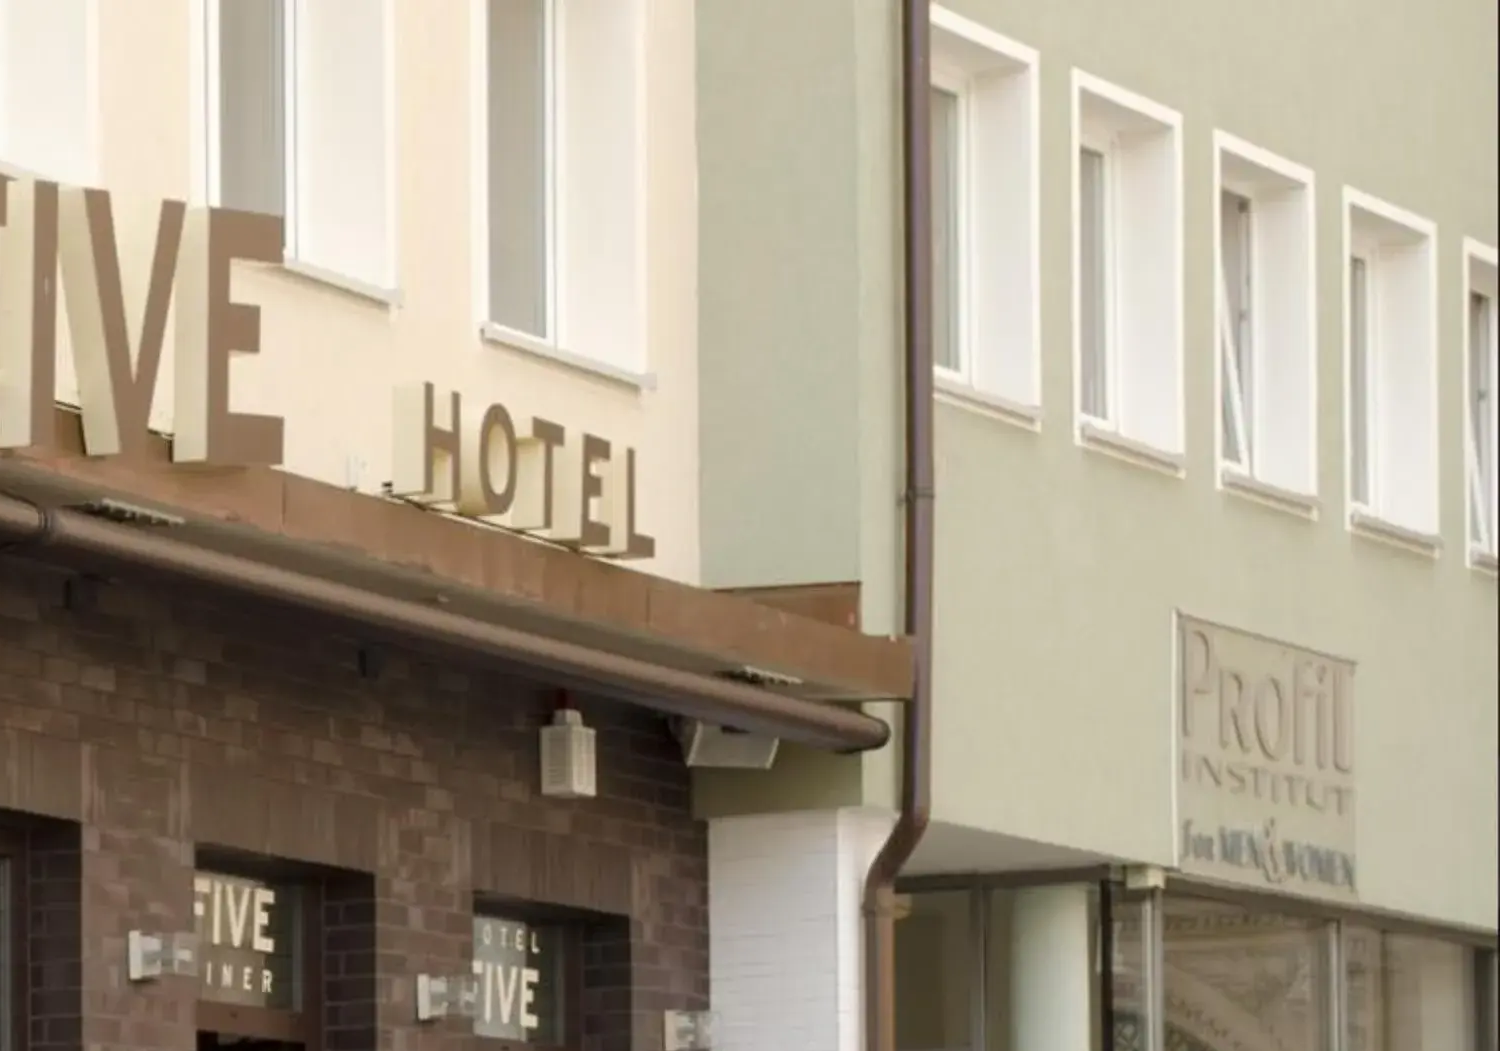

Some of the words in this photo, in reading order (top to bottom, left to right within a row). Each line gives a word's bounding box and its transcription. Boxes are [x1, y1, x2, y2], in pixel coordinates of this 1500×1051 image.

[422, 381, 656, 559] HOTEL
[482, 923, 540, 954] OTEL
[205, 960, 274, 994] INER
[472, 959, 540, 1029] IVE
